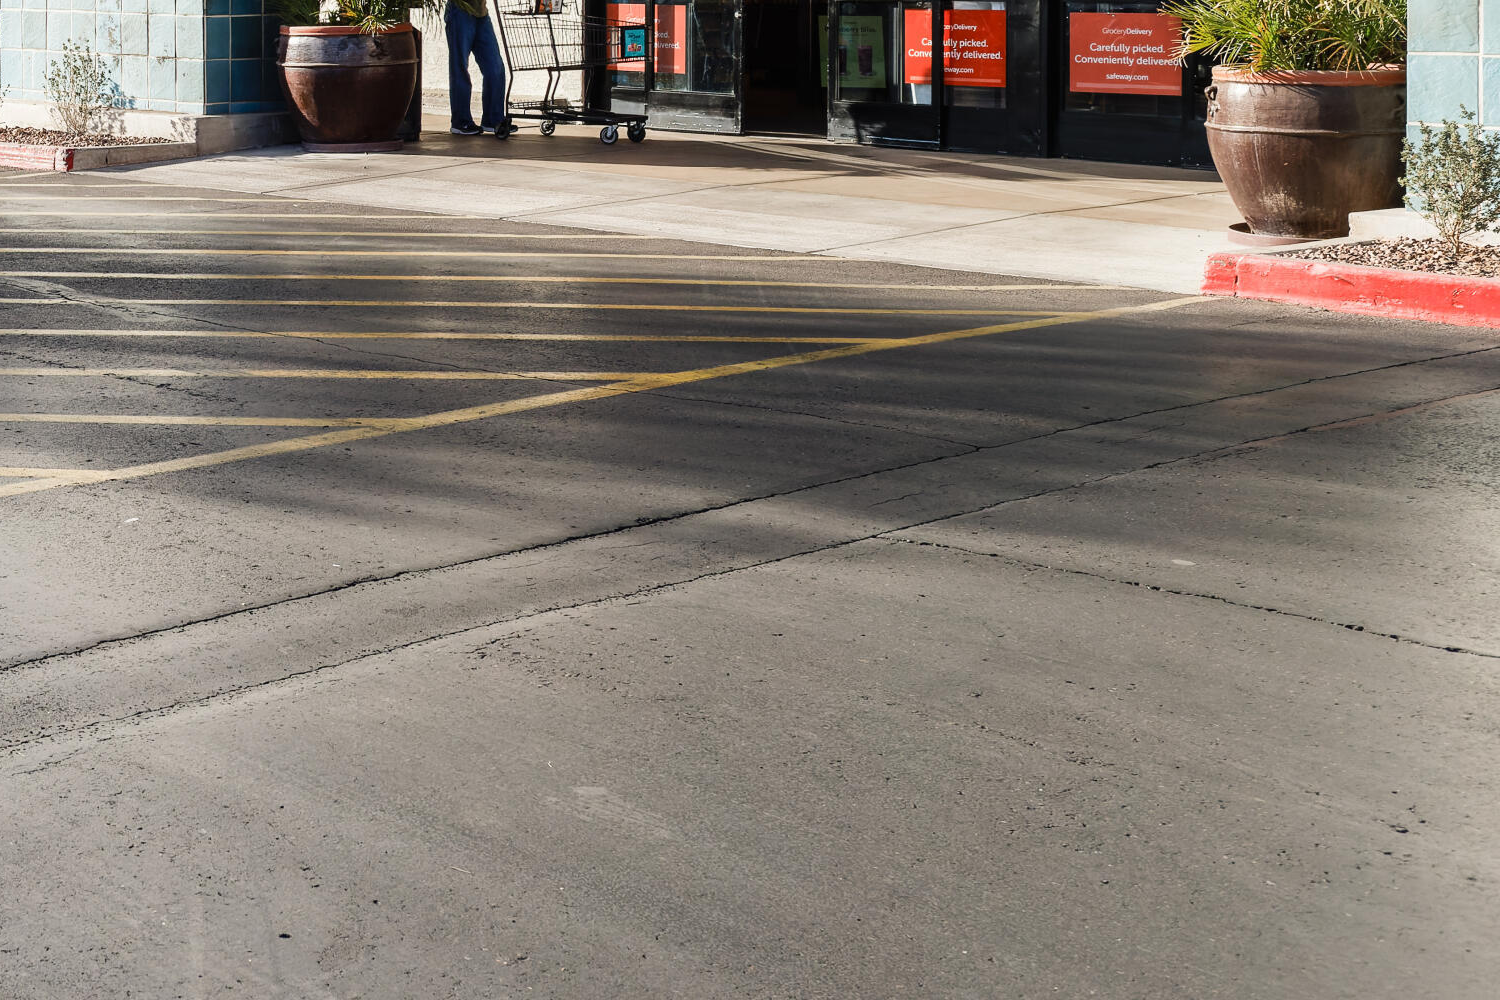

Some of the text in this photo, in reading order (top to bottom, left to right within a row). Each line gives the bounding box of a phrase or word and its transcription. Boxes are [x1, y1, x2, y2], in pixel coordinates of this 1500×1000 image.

[1101, 27, 1153, 37] GroceryDelivery
[921, 37, 989, 49] Caully picked.
[1089, 42, 1166, 54] Carefully picked.
[907, 48, 1004, 60] Conveently delivered.
[1074, 54, 1180, 67] Conveniently delivered
[1105, 73, 1149, 82] safeway.com
